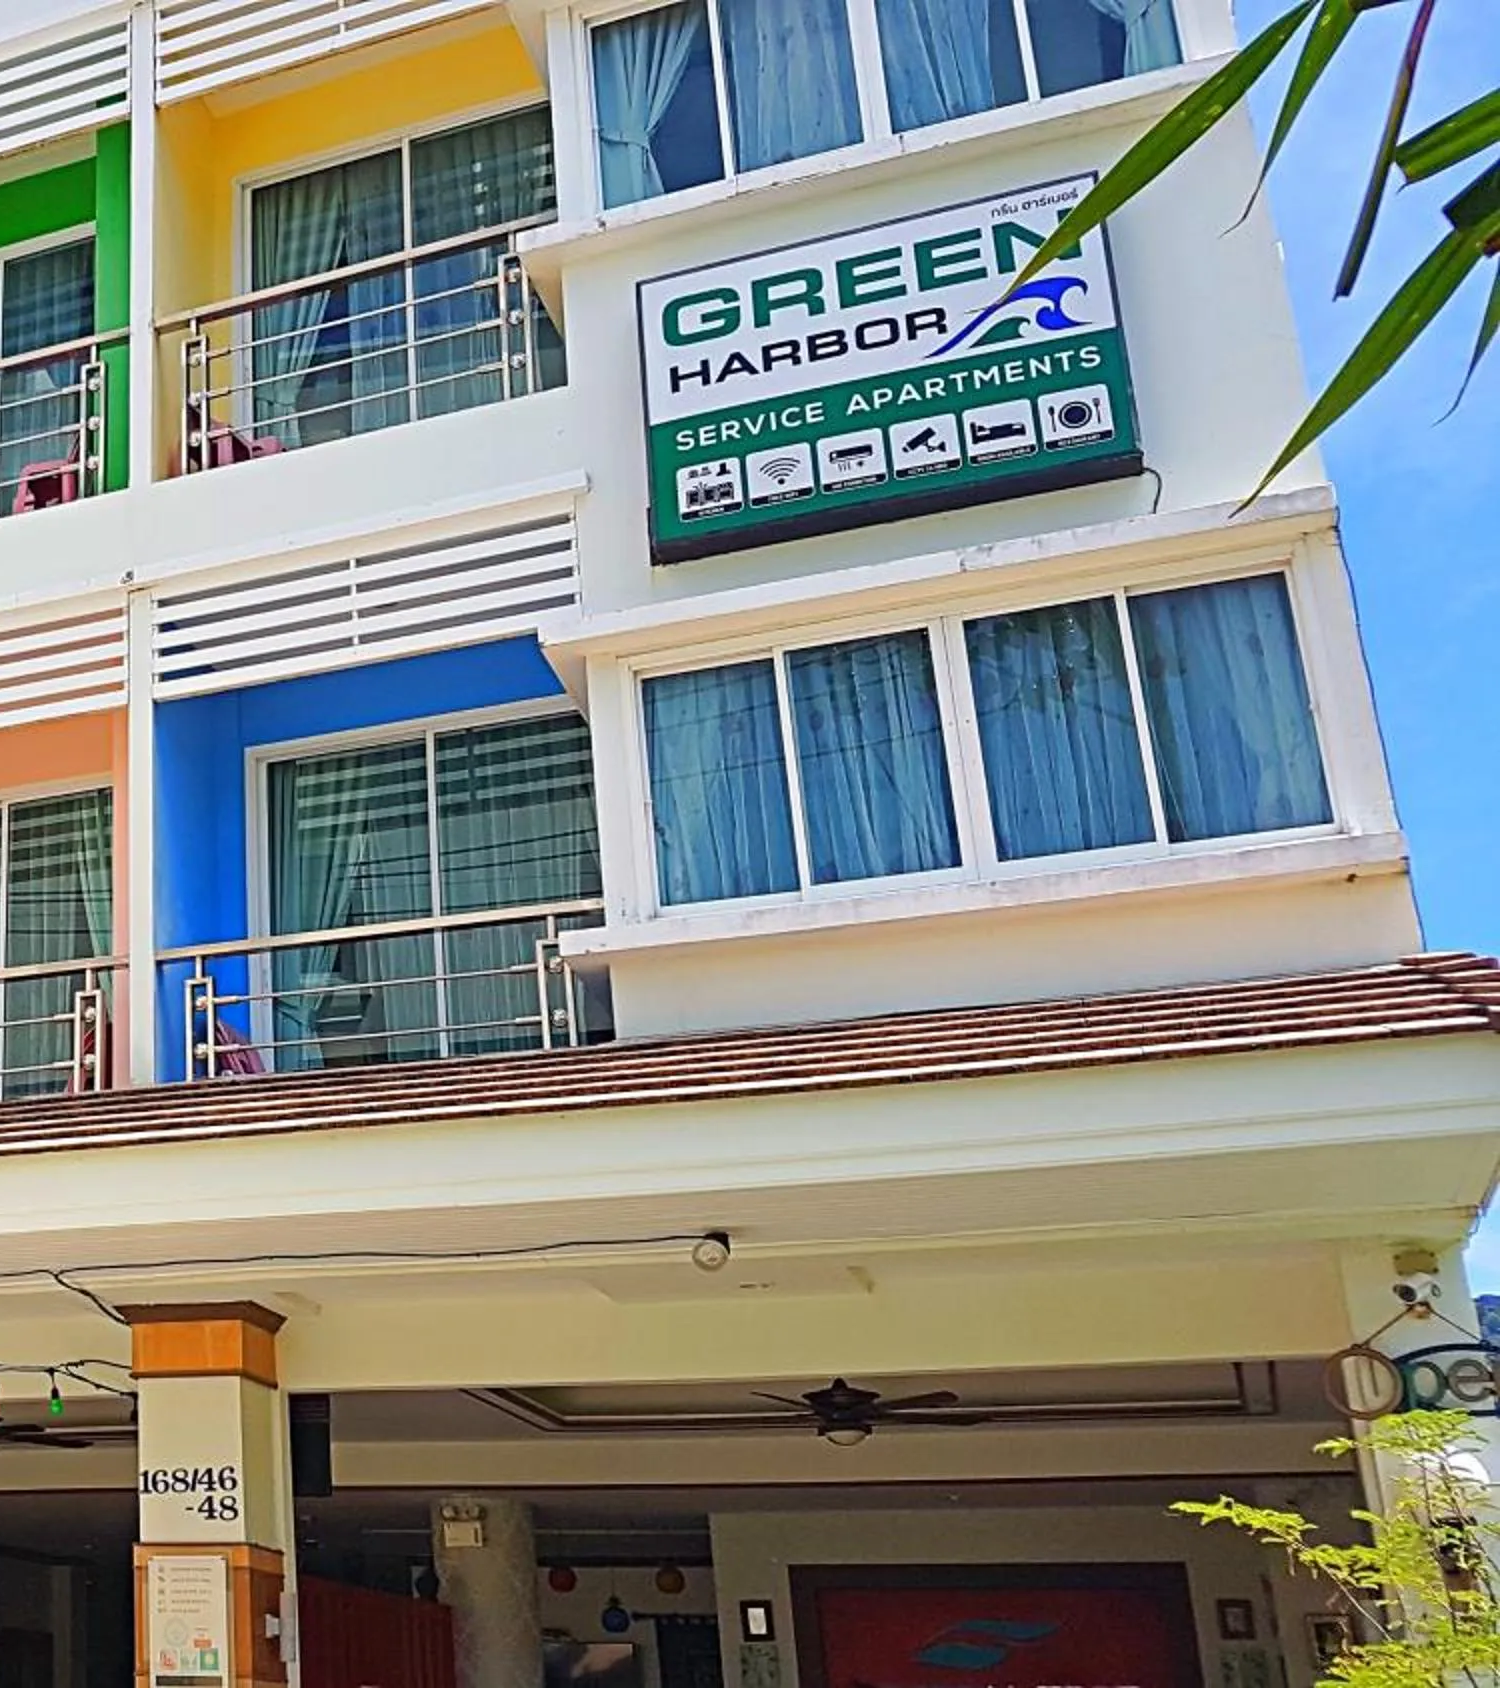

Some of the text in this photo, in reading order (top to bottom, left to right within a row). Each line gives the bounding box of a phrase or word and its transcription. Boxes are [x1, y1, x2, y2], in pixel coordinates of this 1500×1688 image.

[662, 207, 1082, 346] GREEN
[669, 307, 948, 394] HARBOR
[675, 346, 1102, 451] SERVICE APARTMENTS
[1324, 1347, 1500, 1421] Ope
[140, 1466, 238, 1494] 168/46
[185, 1495, 239, 1521] -48
